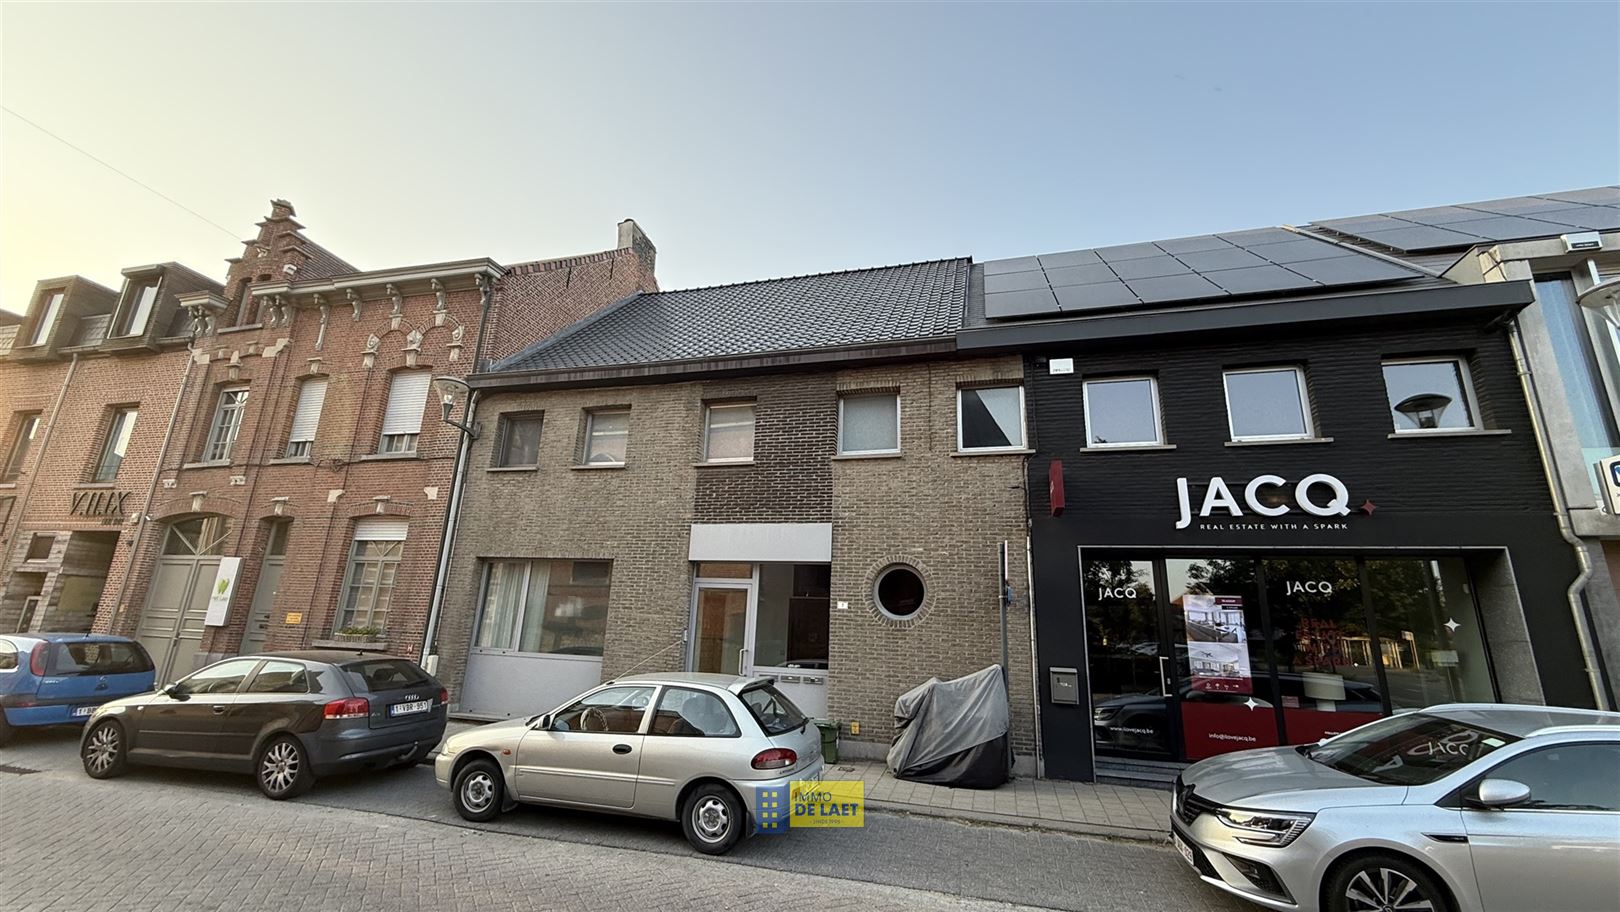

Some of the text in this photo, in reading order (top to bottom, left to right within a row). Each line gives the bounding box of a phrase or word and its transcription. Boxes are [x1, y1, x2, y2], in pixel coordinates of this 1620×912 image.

[1175, 473, 1351, 530] JACQ
[1098, 587, 1137, 601] JACQ
[1286, 580, 1333, 596] JACQ
